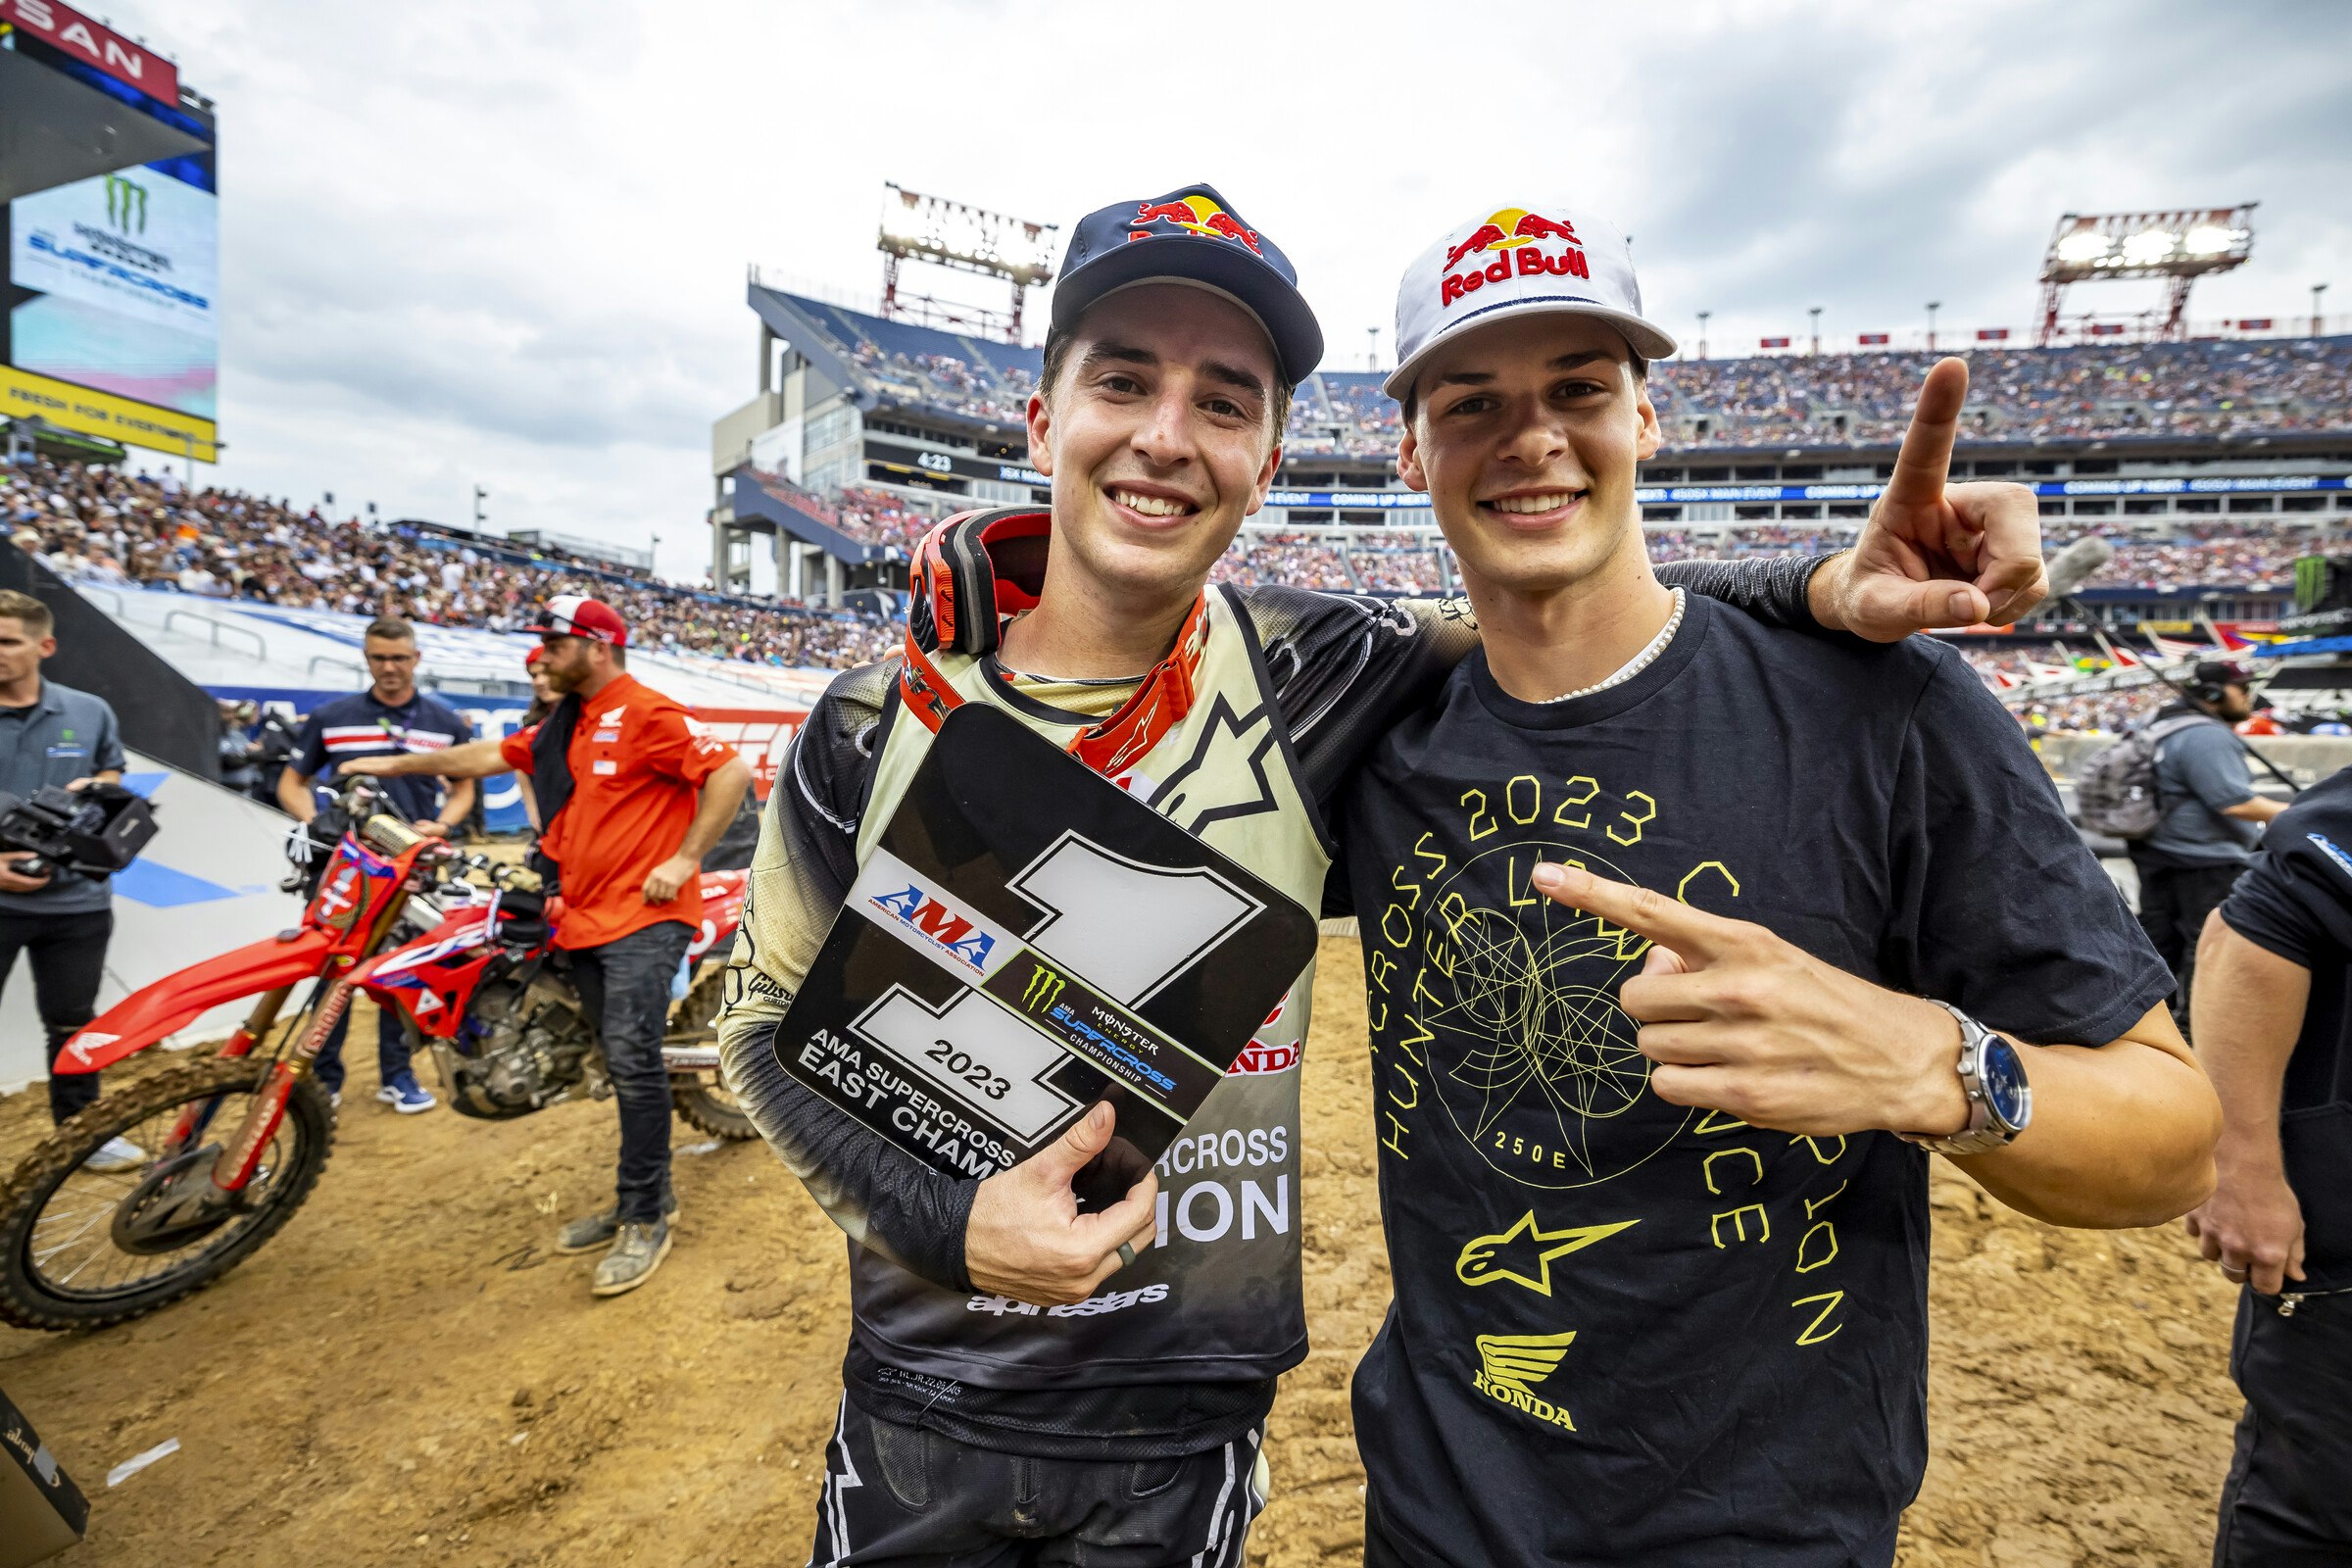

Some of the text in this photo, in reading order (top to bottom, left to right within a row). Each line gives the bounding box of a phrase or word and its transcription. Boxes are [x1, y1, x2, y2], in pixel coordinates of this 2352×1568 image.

[1442, 247, 1590, 307] Red Bull
[917, 452, 952, 472] 4:23
[1461, 775, 1656, 846] 2023
[868, 899, 984, 977] AMERICAN MOTORCYCLIST ASSOCIATION
[871, 883, 996, 971] AMA
[1368, 832, 1446, 1054] CROSS
[1059, 1003, 1075, 1016] AMA
[1098, 1023, 1144, 1054] ENERGY
[1382, 893, 1481, 1159] HUNTER
[924, 1039, 1011, 1101] 2023
[1050, 1006, 1177, 1091] SUPERCROSS
[1069, 1034, 1142, 1083] CHAMPIONSHIP
[798, 1043, 1004, 1180] EAST CHAM
[811, 1029, 1015, 1168] AMA SUPERCROSS
[1494, 1131, 1566, 1170] 250E
[1472, 1368, 1577, 1432] HONDA
